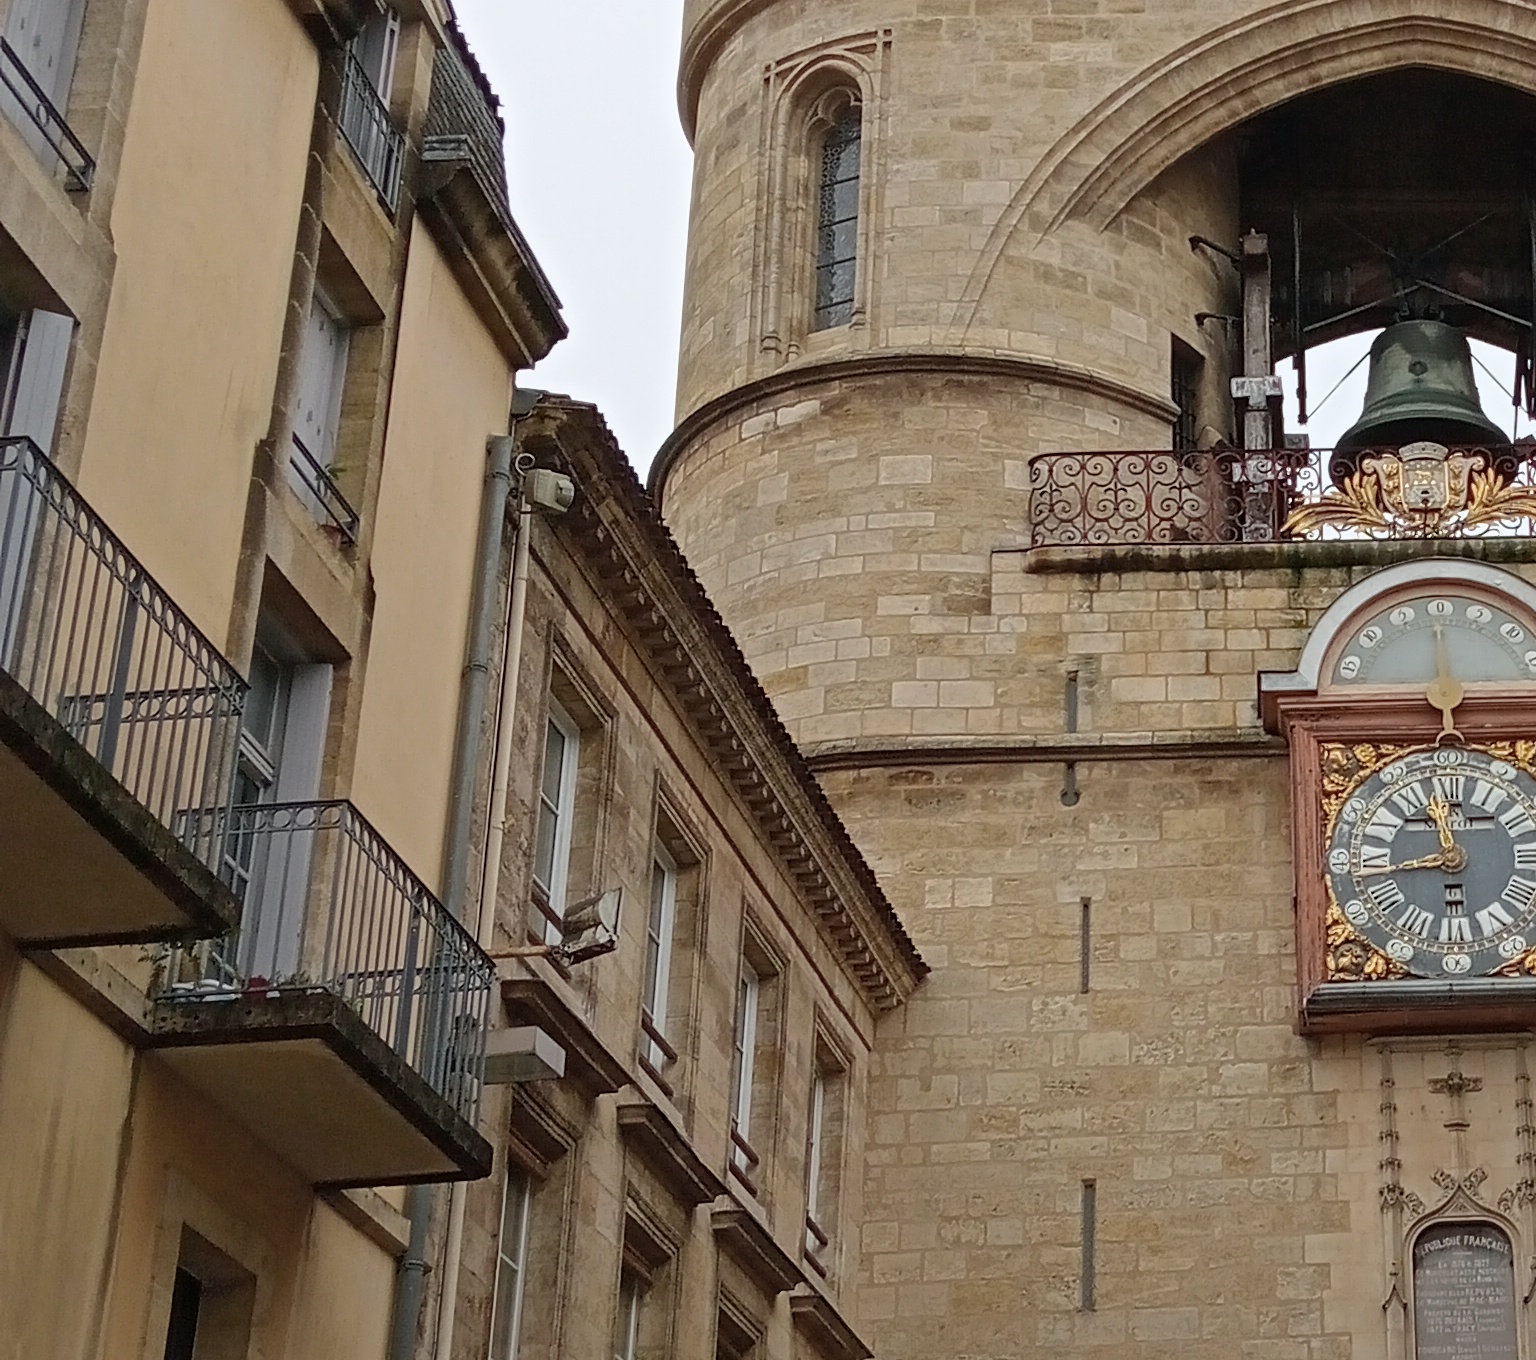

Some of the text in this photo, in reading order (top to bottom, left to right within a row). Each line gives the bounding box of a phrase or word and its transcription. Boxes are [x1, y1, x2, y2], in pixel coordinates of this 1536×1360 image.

[1437, 602, 1444, 613] 0
[1363, 629, 1378, 643] 10
[1505, 625, 1521, 641] 10
[1342, 659, 1357, 674] 15
[1437, 752, 1458, 764] 60
[1383, 765, 1405, 781] 55
[1437, 776, 1459, 800] XII
[1345, 801, 1364, 819] 50
[1397, 786, 1423, 816] XI
[1424, 820, 1473, 829] Mrdi
[1505, 811, 1528, 830] II
[1332, 850, 1349, 871] 45
[1363, 848, 1388, 868] IX
[1347, 902, 1366, 921] 40
[1403, 909, 1429, 935] VII
[1447, 919, 1465, 941] VI
[1486, 909, 1506, 933] V
[1389, 942, 1413, 960] 35
[1502, 938, 1524, 955] 25
[1445, 958, 1467, 970] 30
